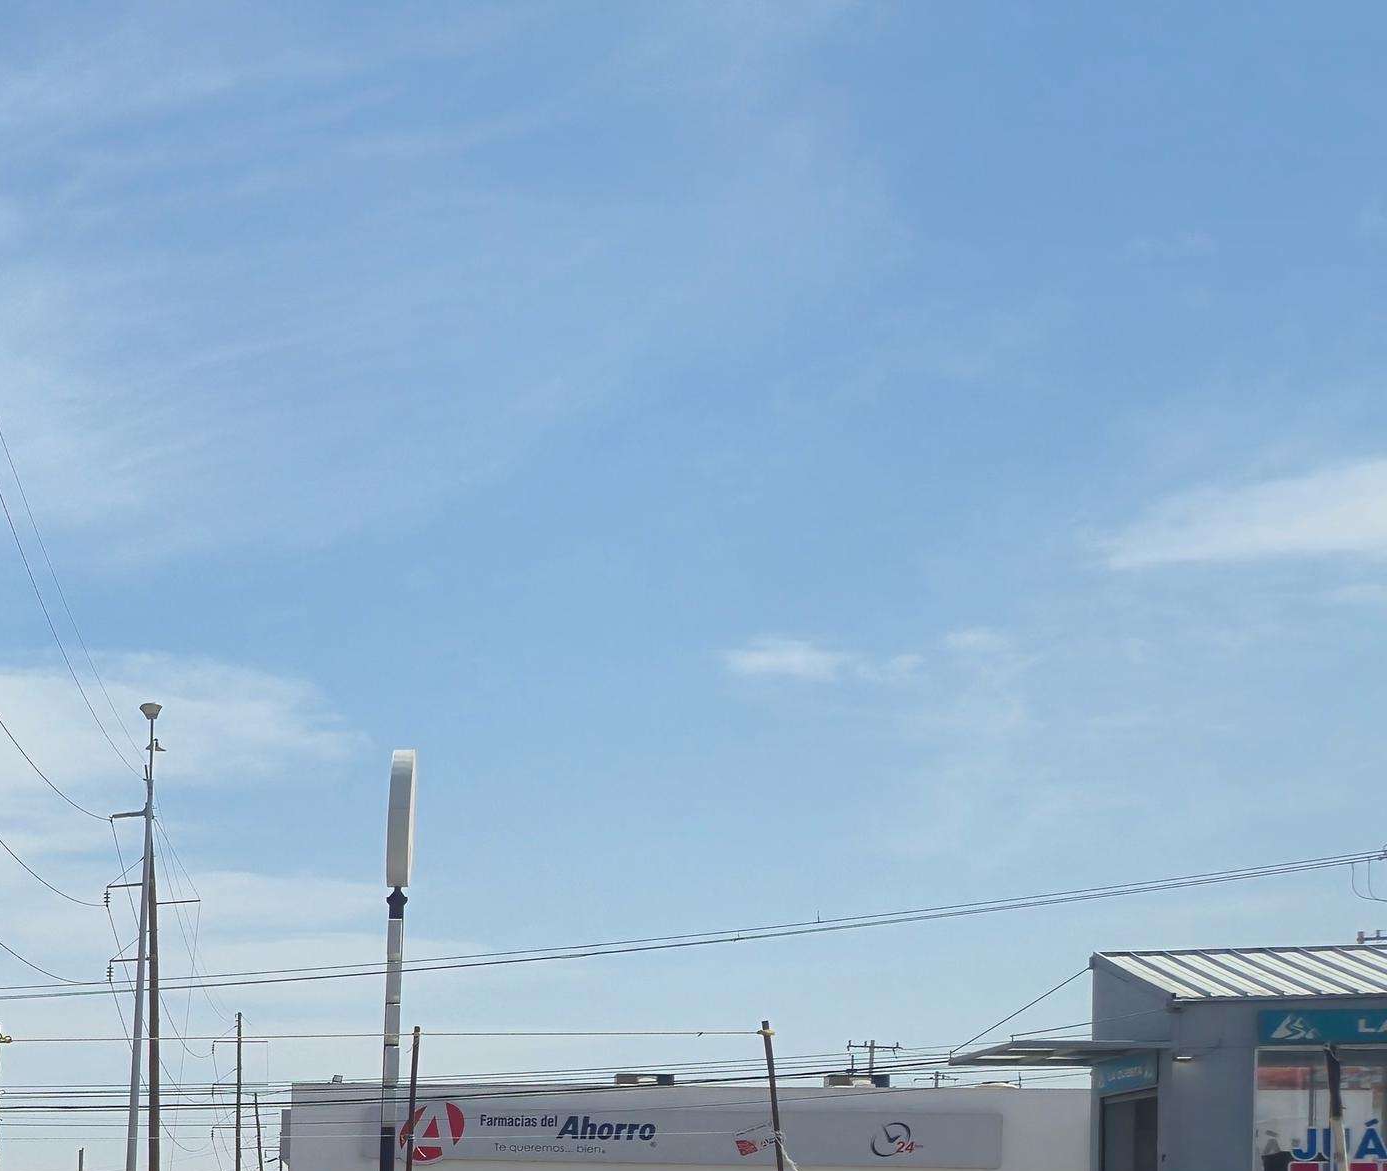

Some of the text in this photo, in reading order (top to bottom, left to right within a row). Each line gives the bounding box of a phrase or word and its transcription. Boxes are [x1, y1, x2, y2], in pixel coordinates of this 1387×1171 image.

[480, 1114, 656, 1141] Farmacias del Ahorro
[494, 1142, 507, 1152] Te
[896, 1141, 915, 1153] 24
